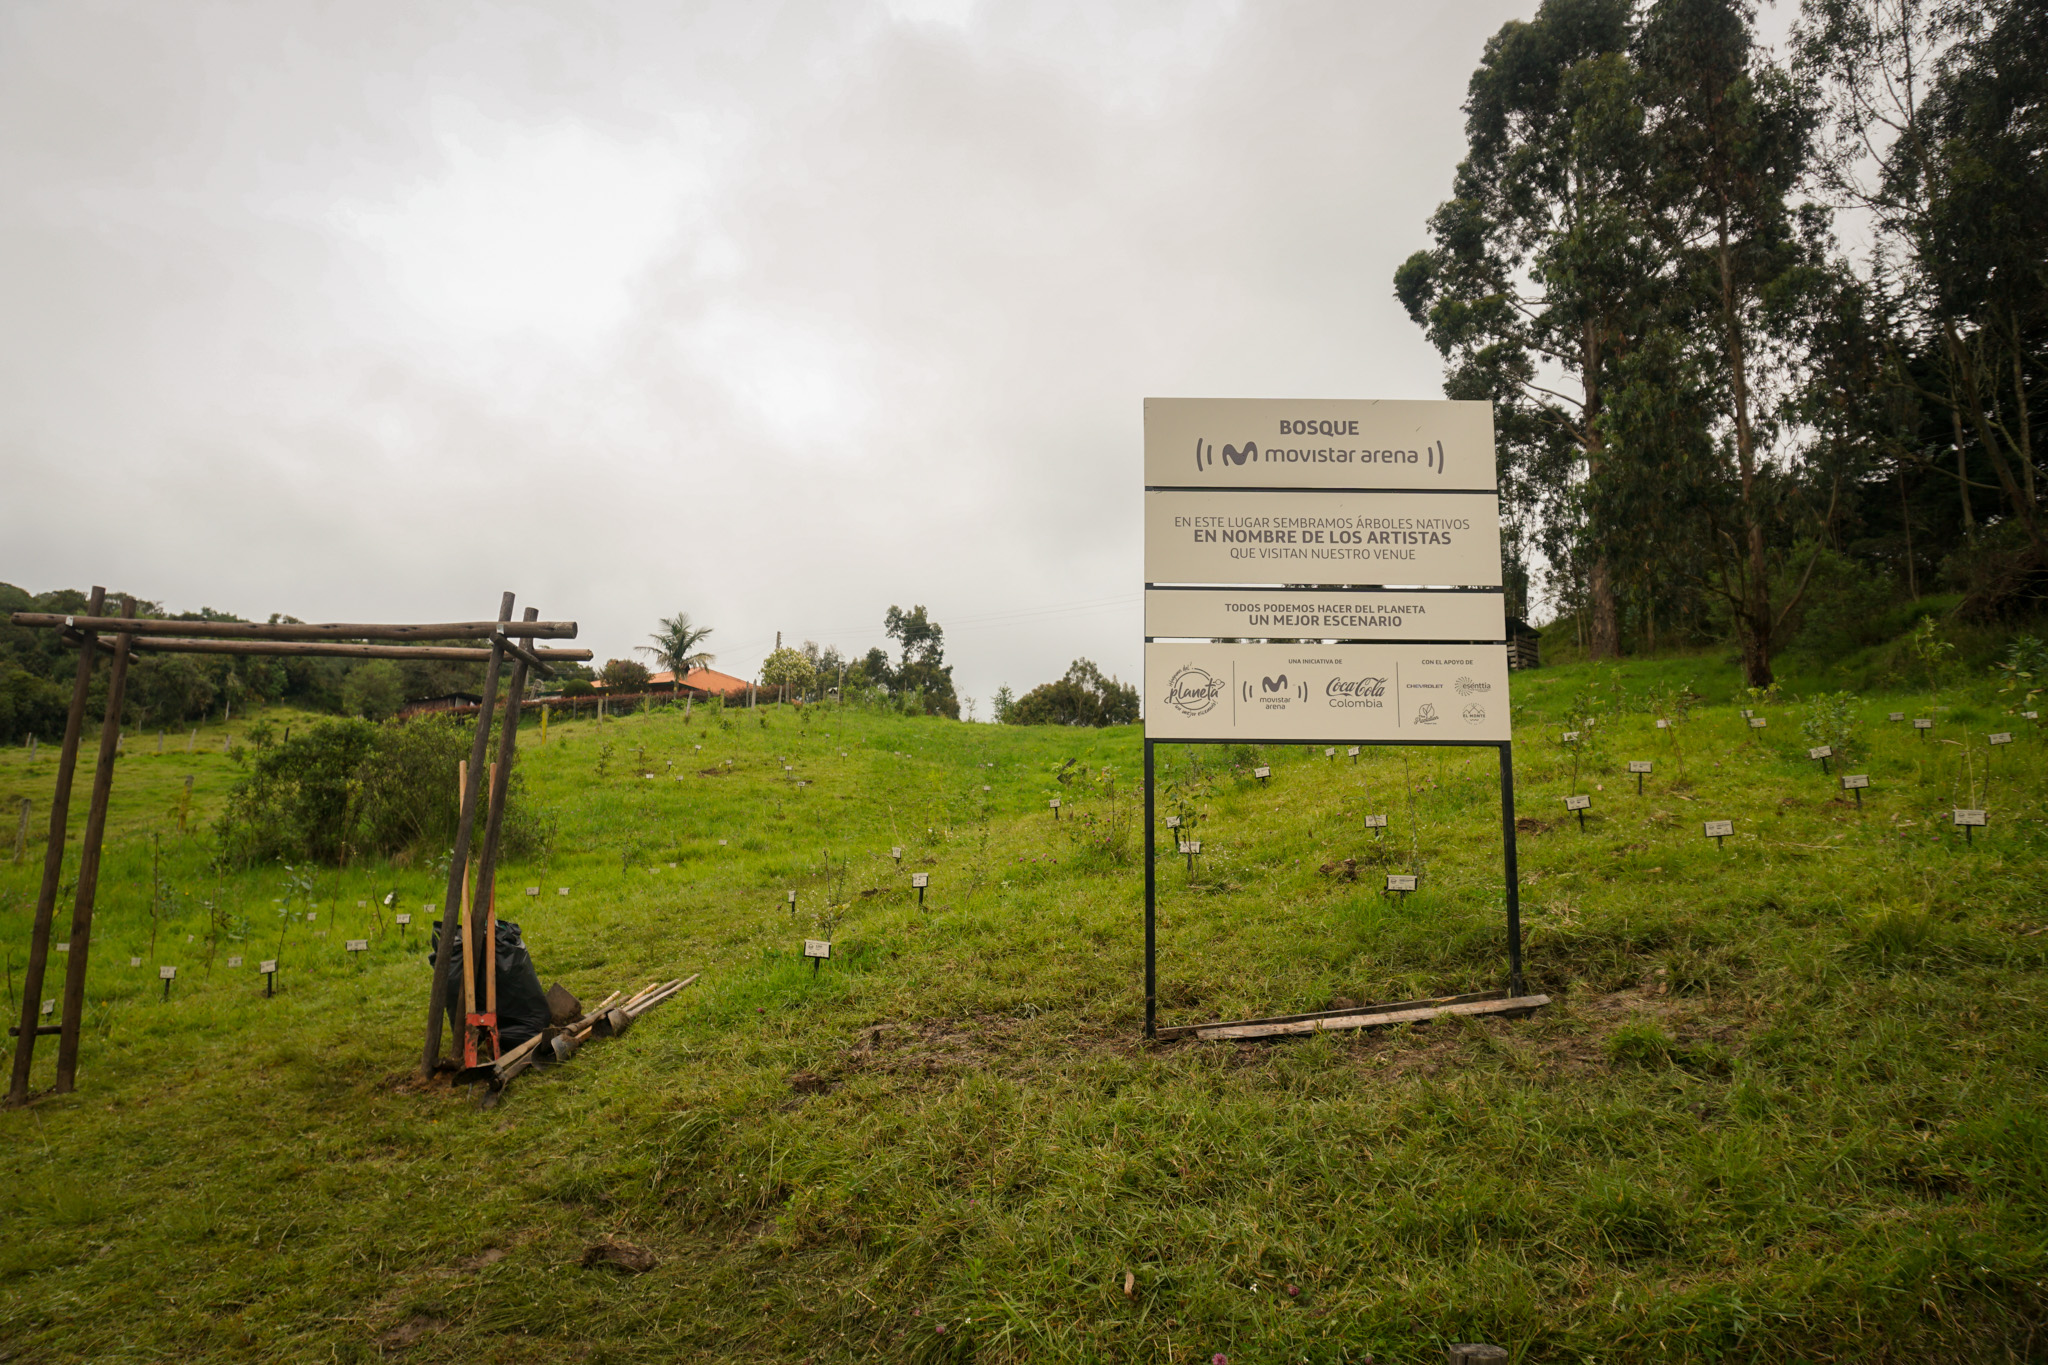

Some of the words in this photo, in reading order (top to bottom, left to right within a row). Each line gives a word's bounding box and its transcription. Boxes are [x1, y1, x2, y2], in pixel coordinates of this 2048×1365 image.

[1279, 419, 1360, 437] BOSQUE
[1265, 447, 1356, 463] movistar
[1361, 448, 1419, 464] arena
[1174, 516, 1193, 528] EN
[1194, 516, 1225, 528] ESTE
[1227, 516, 1271, 529] LUGAR
[1272, 517, 1354, 529] SEMBRAMOS
[1356, 515, 1414, 530] ÁRBOLES
[1416, 518, 1471, 530] NATIVOS
[1193, 529, 1217, 543] EN
[1221, 529, 1298, 544] NOMBRE
[1301, 530, 1325, 544] DE
[1329, 530, 1363, 545] LOS
[1366, 530, 1452, 546] ARTISTAS
[1229, 547, 1257, 560] QUE
[1258, 547, 1309, 559] VISITAN
[1311, 548, 1371, 560] NUESTRO
[1373, 548, 1417, 561] VENUE
[1224, 603, 1262, 613] TODOS
[1263, 603, 1316, 614] PODEMOS
[1318, 604, 1353, 614] HACER
[1354, 604, 1375, 614] DEL
[1377, 605, 1426, 615] PLANETA
[1248, 614, 1270, 626] UN
[1273, 614, 1320, 627] MEJOR
[1323, 615, 1403, 628] ESCENARIO
[1169, 678, 1219, 704] planeta
[1326, 676, 1389, 697] Coca-Cola
[1259, 696, 1291, 704] movistar
[1328, 698, 1383, 709] Colombia
